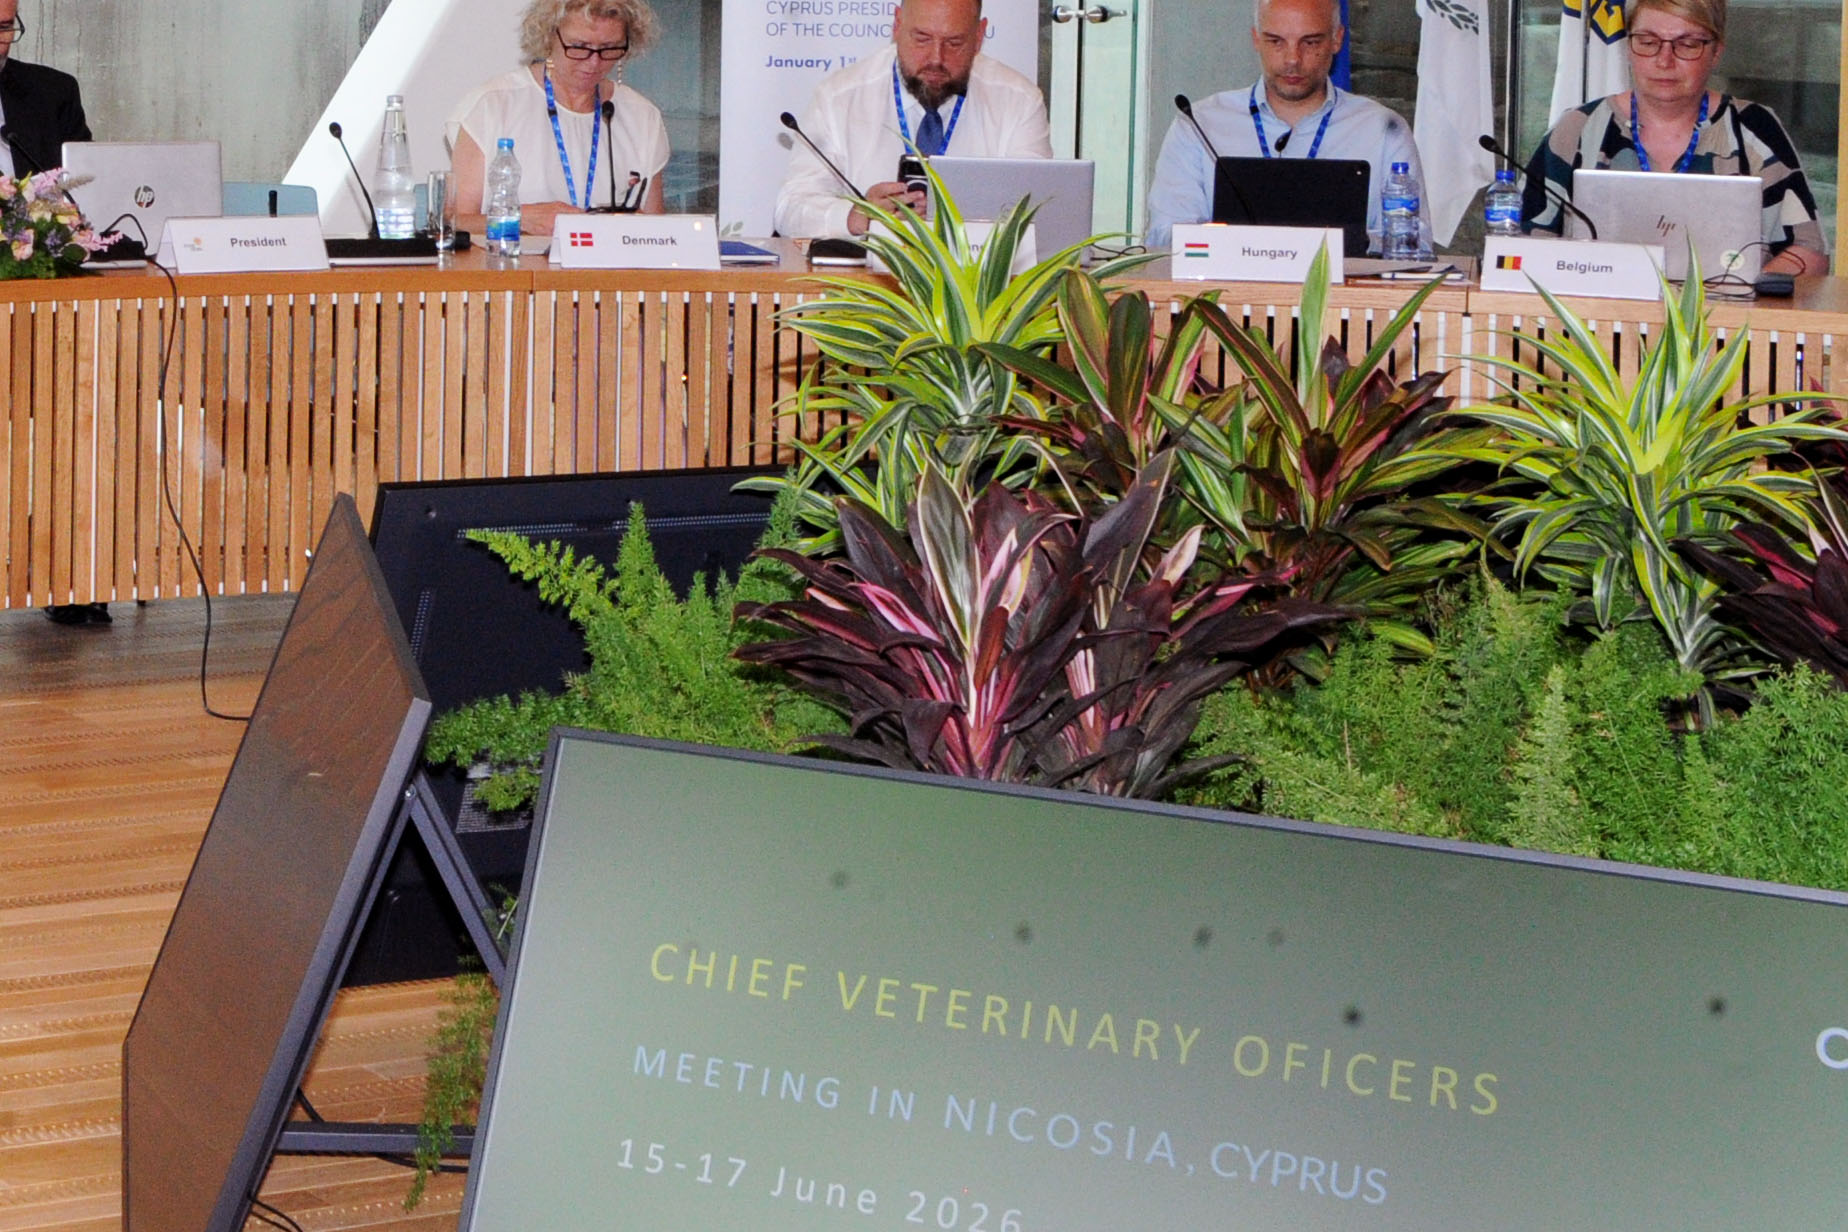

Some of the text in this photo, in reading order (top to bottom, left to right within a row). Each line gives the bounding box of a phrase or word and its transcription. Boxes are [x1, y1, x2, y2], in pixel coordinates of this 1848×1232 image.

[766, 0, 896, 16] CYPRUS PRESID
[766, 22, 788, 37] OF
[792, 22, 824, 37] THE
[829, 23, 892, 38] COUNC
[765, 55, 832, 72] January
[230, 236, 287, 248] President
[622, 235, 677, 247] Denmark
[1241, 246, 1298, 260] Hungary
[1556, 260, 1613, 274] Belgium
[651, 943, 1498, 1116] CHIEF VETERINARY OFICERS
[633, 1045, 1388, 1204] MEETING IN NICOSIA, CYPRUS
[617, 1138, 1023, 1232] 15-17 June 2026
